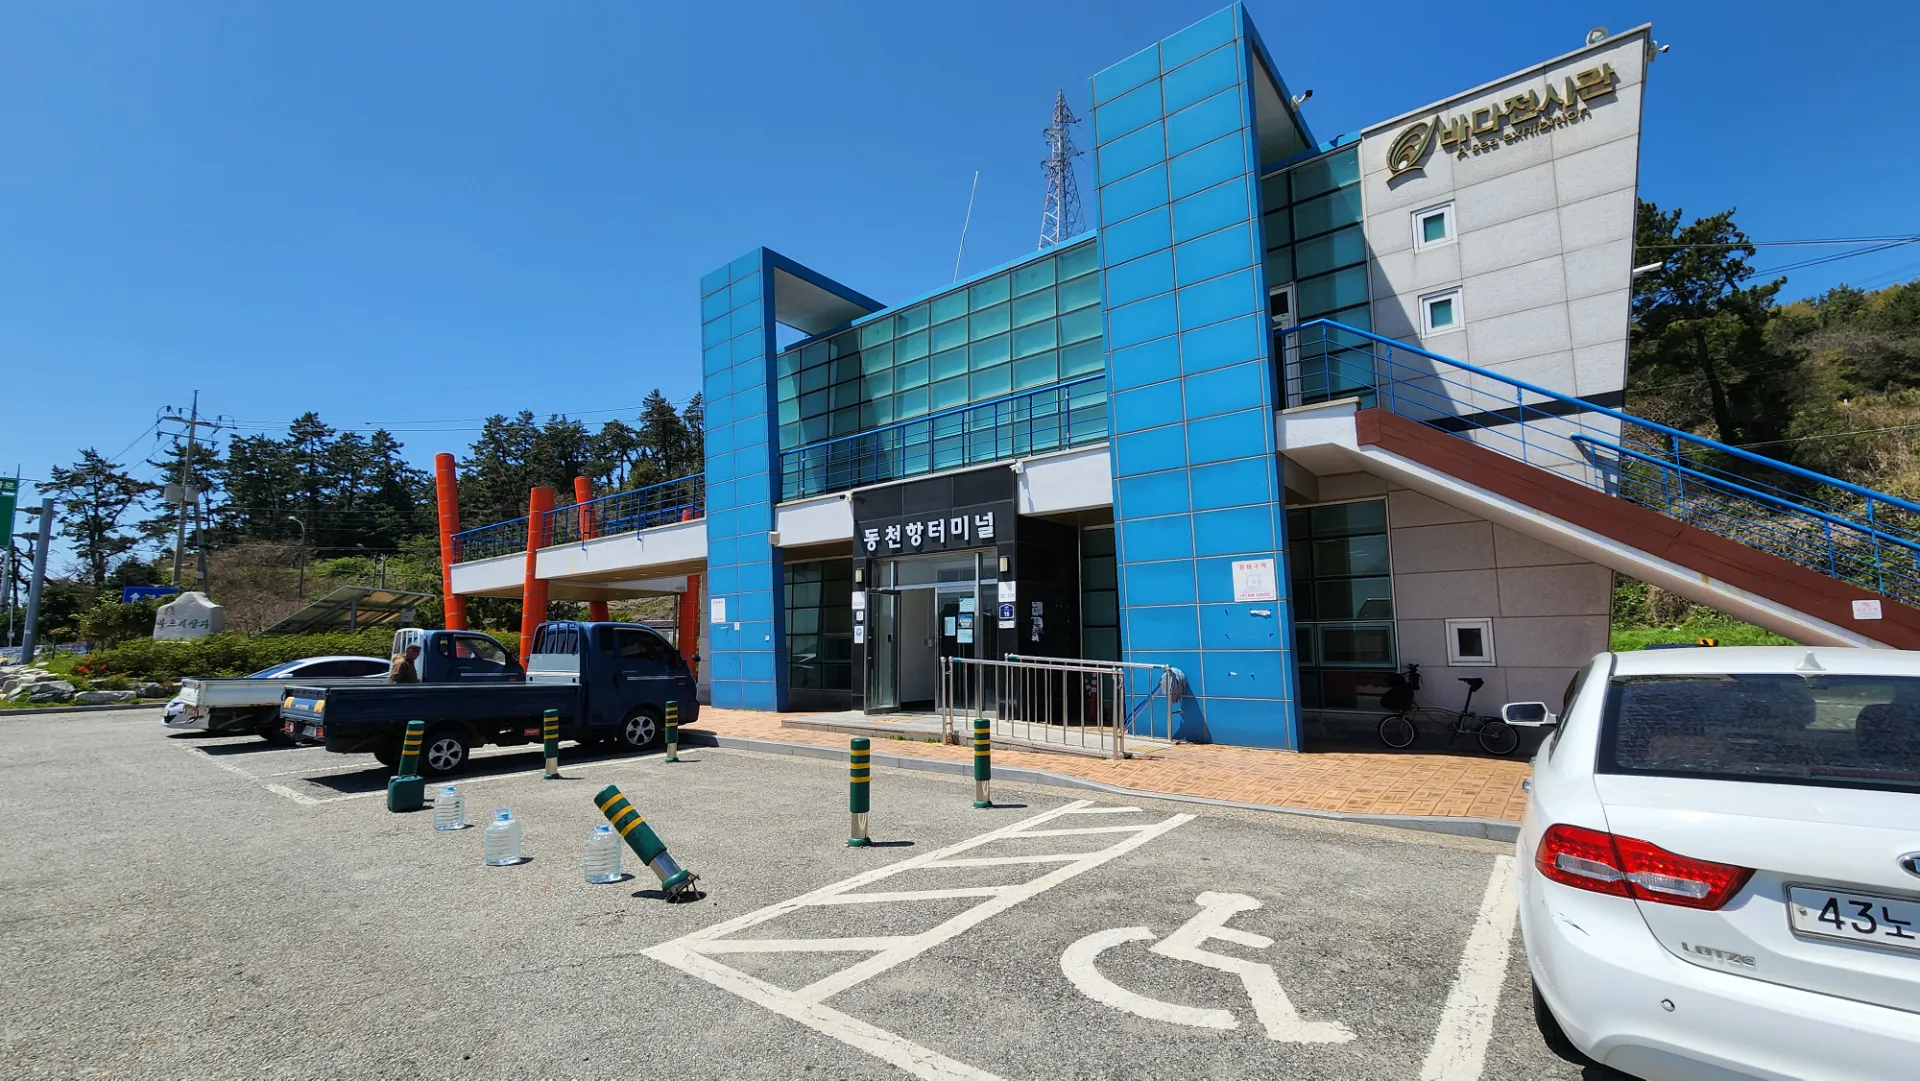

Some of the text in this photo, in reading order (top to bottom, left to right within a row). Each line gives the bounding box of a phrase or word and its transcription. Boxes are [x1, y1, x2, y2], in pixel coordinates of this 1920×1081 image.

[1439, 62, 1616, 146] 바다전시관
[1457, 107, 1590, 157] A sea exhibition
[864, 511, 995, 551] 동천항터미널
[1817, 896, 1916, 940] 43노
